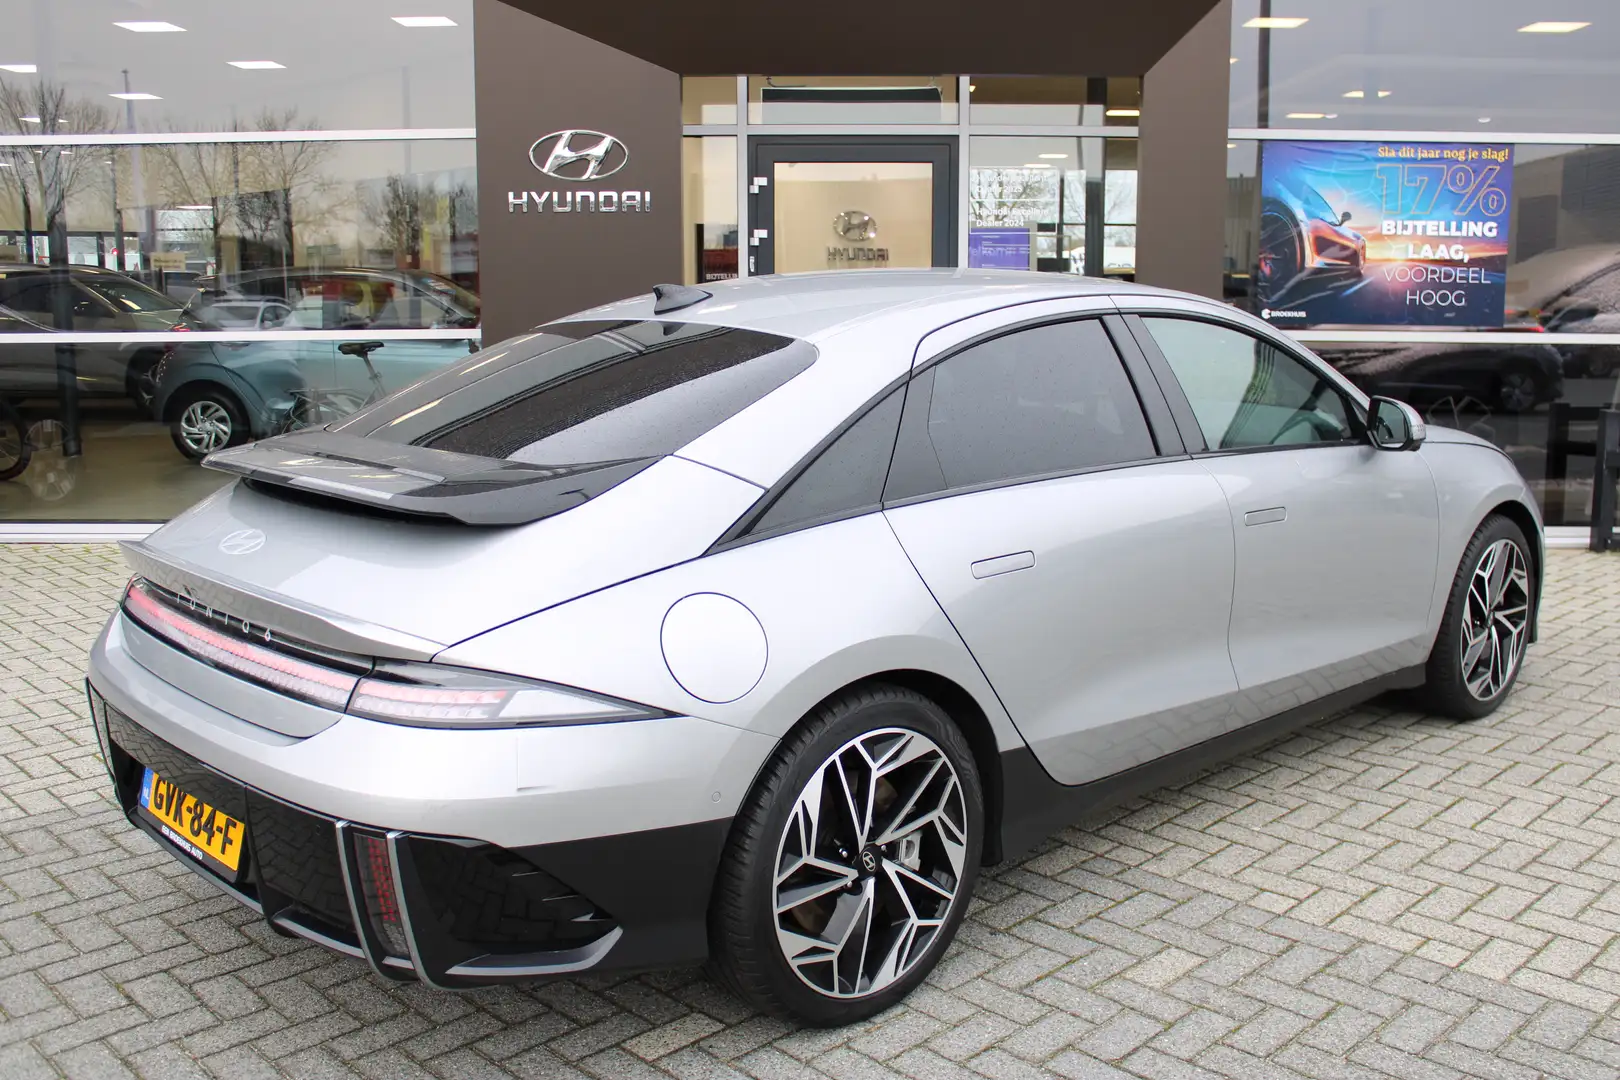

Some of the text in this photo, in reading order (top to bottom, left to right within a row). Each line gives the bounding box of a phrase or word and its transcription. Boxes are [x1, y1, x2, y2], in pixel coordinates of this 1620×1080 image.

[1378, 147, 1509, 163] Sla dit jaar nog je slag!
[1376, 164, 1507, 217] 17%
[508, 191, 651, 213] HYUNDAI
[976, 219, 1024, 227] Dealer 2024
[1381, 221, 1499, 238] BIJTELLING
[827, 246, 889, 261] HYUNDAI
[1407, 244, 1470, 263] LAAG,
[1383, 267, 1492, 284] VOORDEEL
[1406, 290, 1466, 306] HOOG
[177, 593, 271, 642] IONIQ 6
[153, 777, 237, 855] GVK-84-F
[190, 846, 203, 860] AUTO
